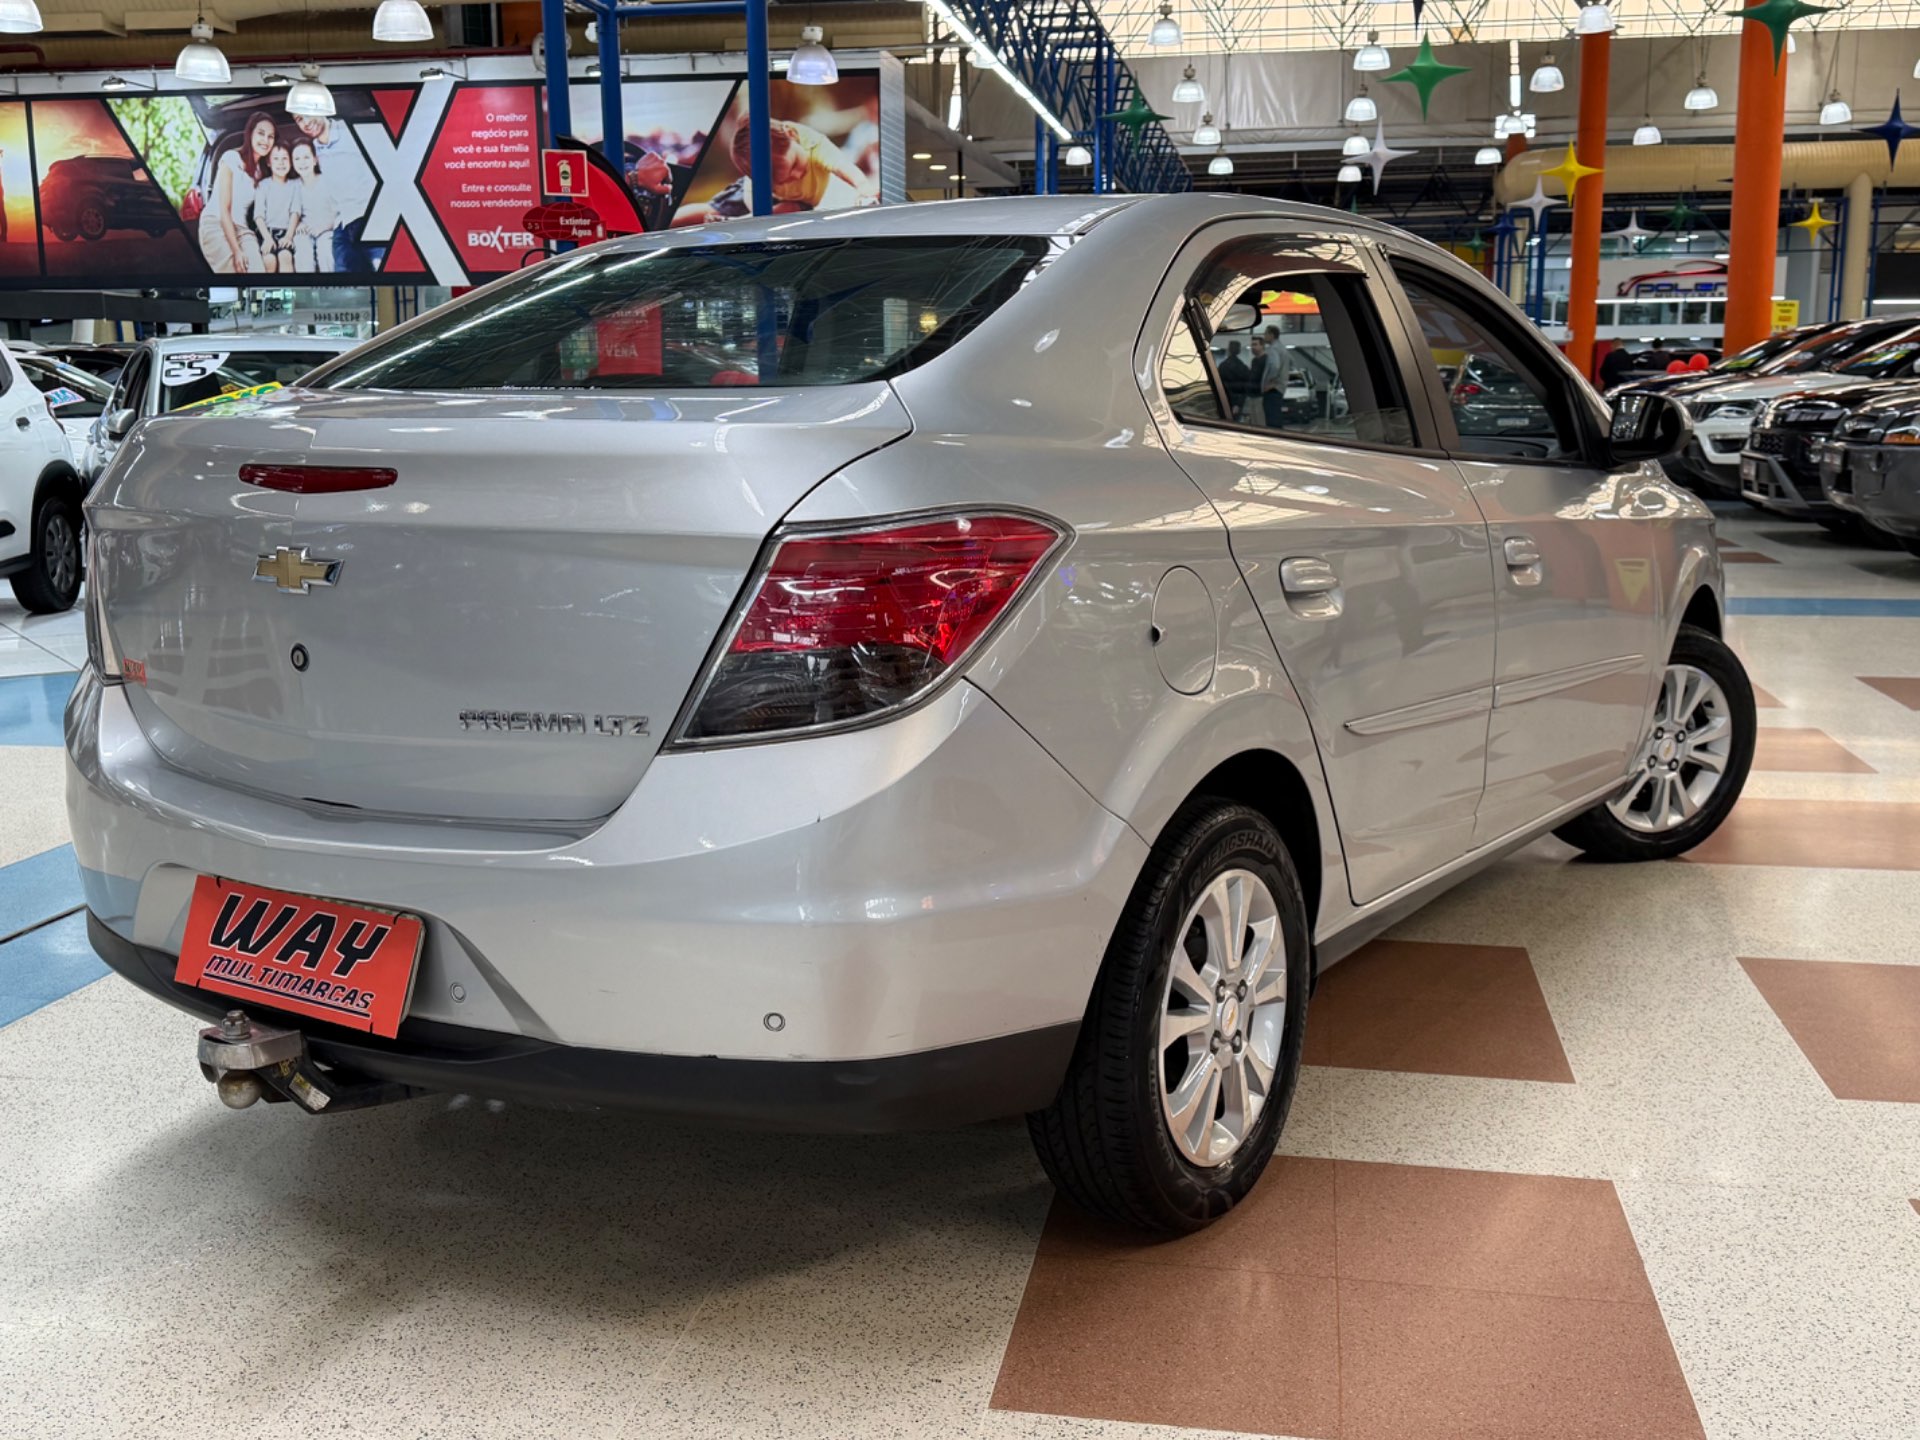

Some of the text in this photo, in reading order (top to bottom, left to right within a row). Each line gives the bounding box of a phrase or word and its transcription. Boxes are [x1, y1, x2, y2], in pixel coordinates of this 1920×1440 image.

[486, 113, 528, 123] O melhor
[472, 128, 529, 140] negócio para
[453, 143, 529, 153] você e sua família
[444, 158, 530, 170] você encontra aqui!
[462, 183, 532, 193] Entre e consulte
[450, 198, 533, 208] nossos vendedores
[559, 216, 591, 226] Extintor
[467, 226, 535, 253] BOXTER
[459, 709, 650, 737] PRISMA LTZ
[208, 892, 392, 979] WAY
[205, 954, 375, 1010] MULTIMARCAS
